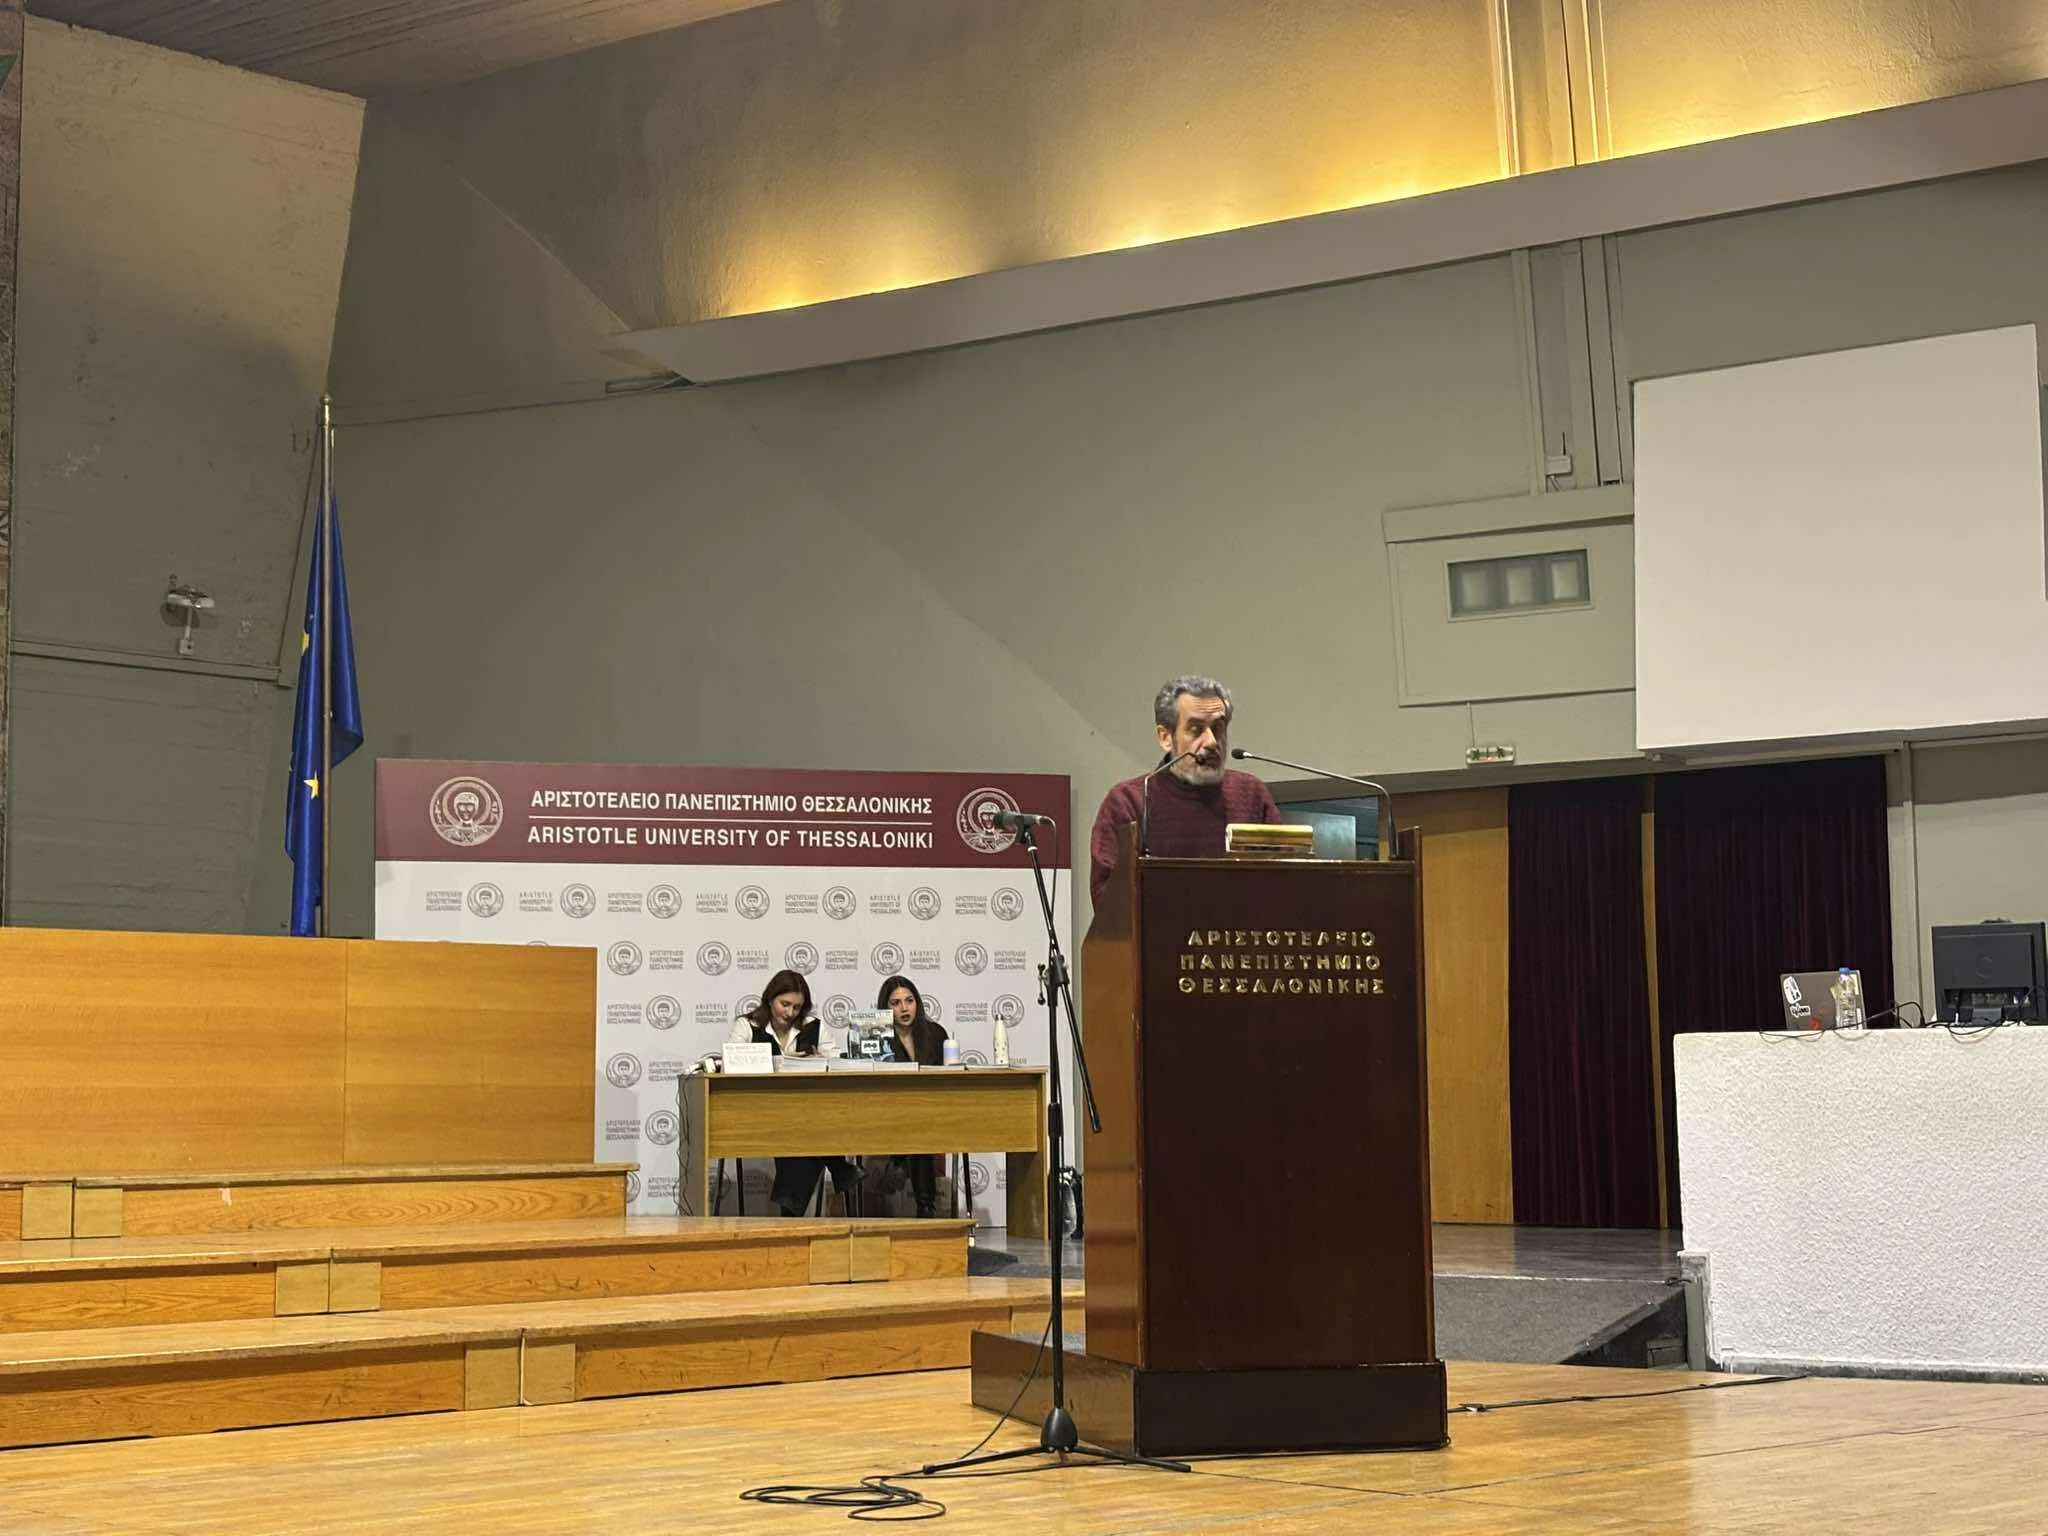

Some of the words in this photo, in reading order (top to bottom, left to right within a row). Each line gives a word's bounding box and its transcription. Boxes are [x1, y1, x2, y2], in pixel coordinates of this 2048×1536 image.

[531, 790, 660, 810] ΑΡΙΣΤΟΤΕΛΕΙΟ
[665, 793, 797, 813] ΠΑΝΕΠΙΣΤΗΜΙΟ
[802, 795, 932, 814] ΘΕΣΣΑΛΟΝΙΚΗΣ
[528, 826, 637, 844] ARISTOTLE
[645, 828, 759, 847] UNIVERSITY
[765, 829, 790, 847] OF
[797, 830, 933, 849] THESSALONIKI
[1187, 930, 1376, 947] ΑΡΙΣΤΟΤΕΛΕΙΟ
[1180, 953, 1381, 970] ΠΑΝΕΠΙΣΤΗΜΙΟ
[1178, 977, 1385, 994] ΘΕΣΣΑΛΟΝΙΚΗΣ
